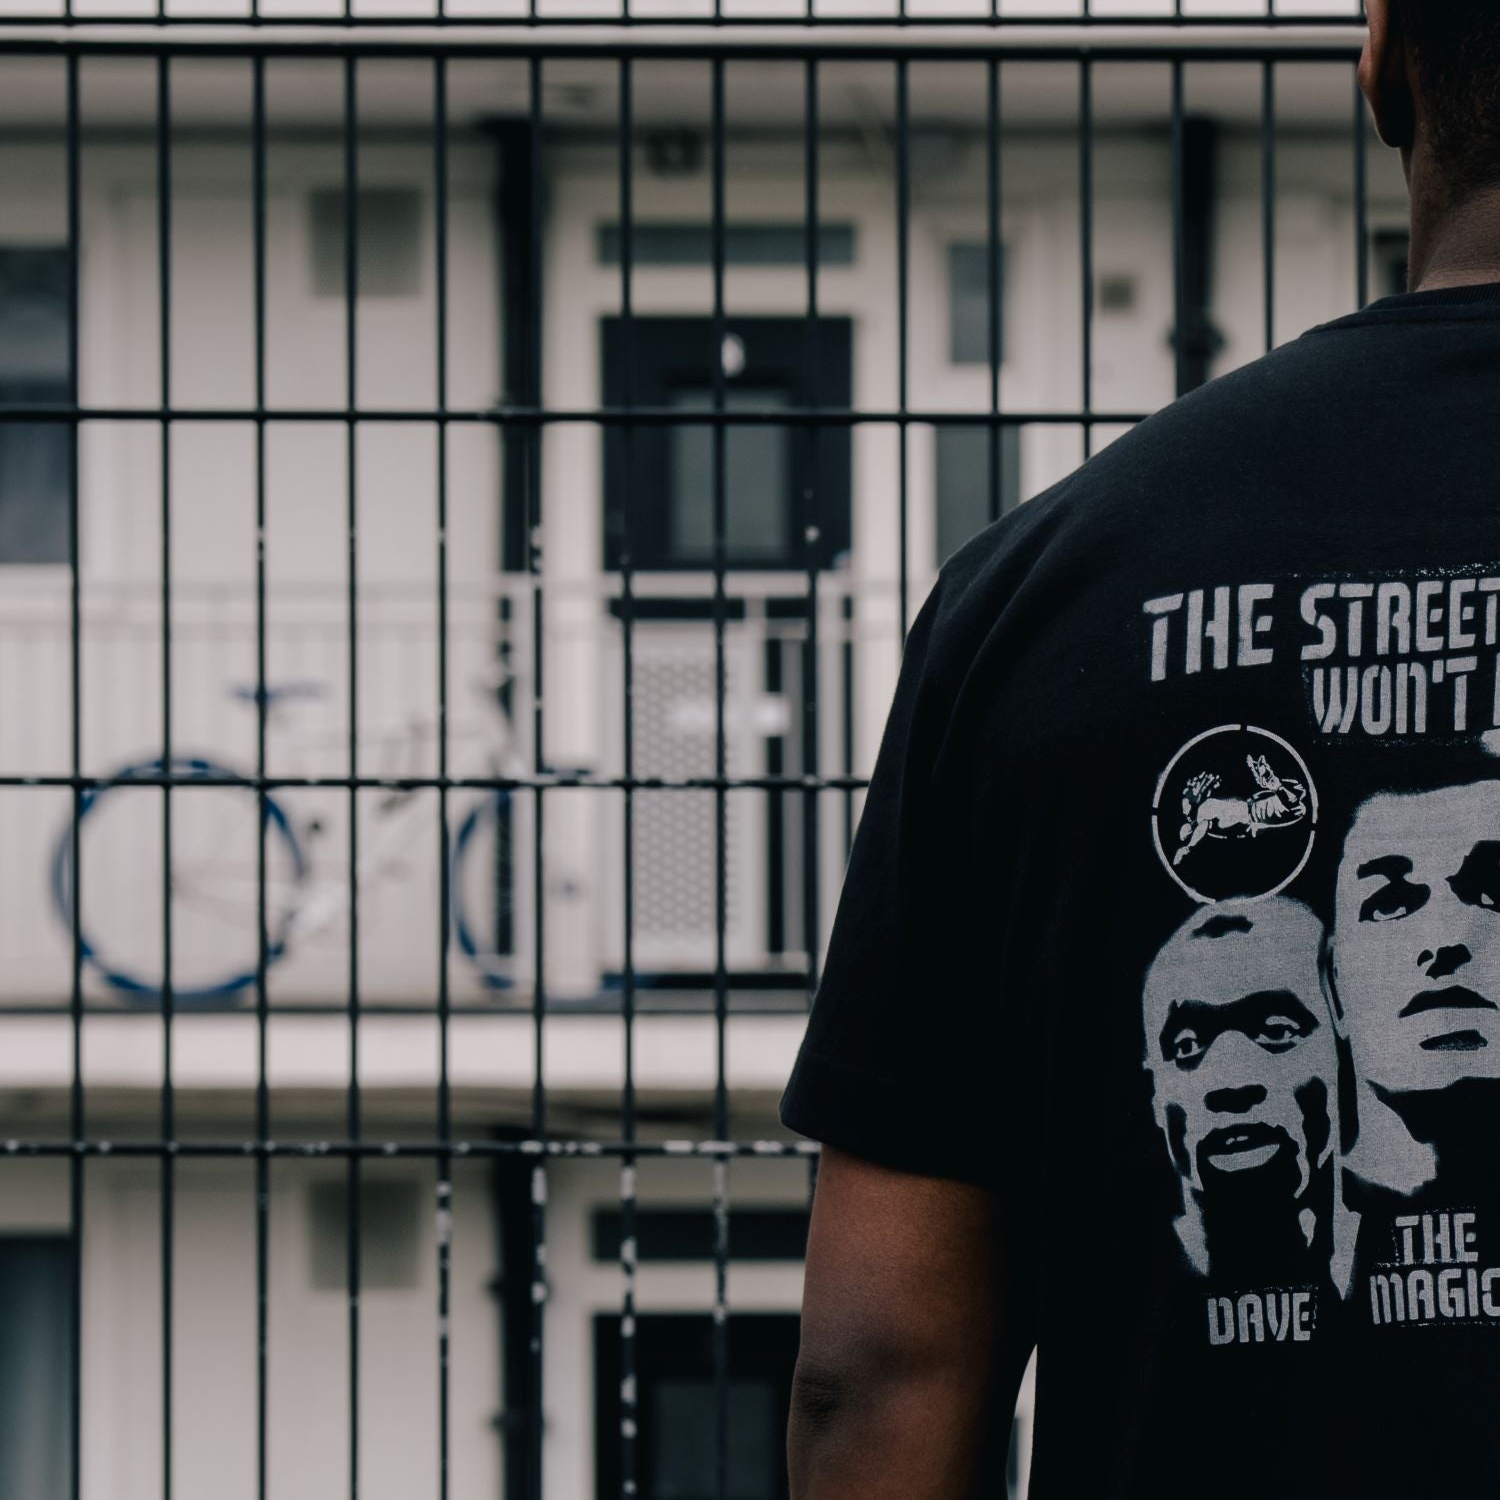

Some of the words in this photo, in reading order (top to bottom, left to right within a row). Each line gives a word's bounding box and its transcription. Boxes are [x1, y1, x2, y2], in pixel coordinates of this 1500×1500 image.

[1142, 583, 1275, 682] THE
[1312, 656, 1478, 736] WON'T
[1395, 1212, 1480, 1265] THE
[1207, 1292, 1312, 1346] DAVE
